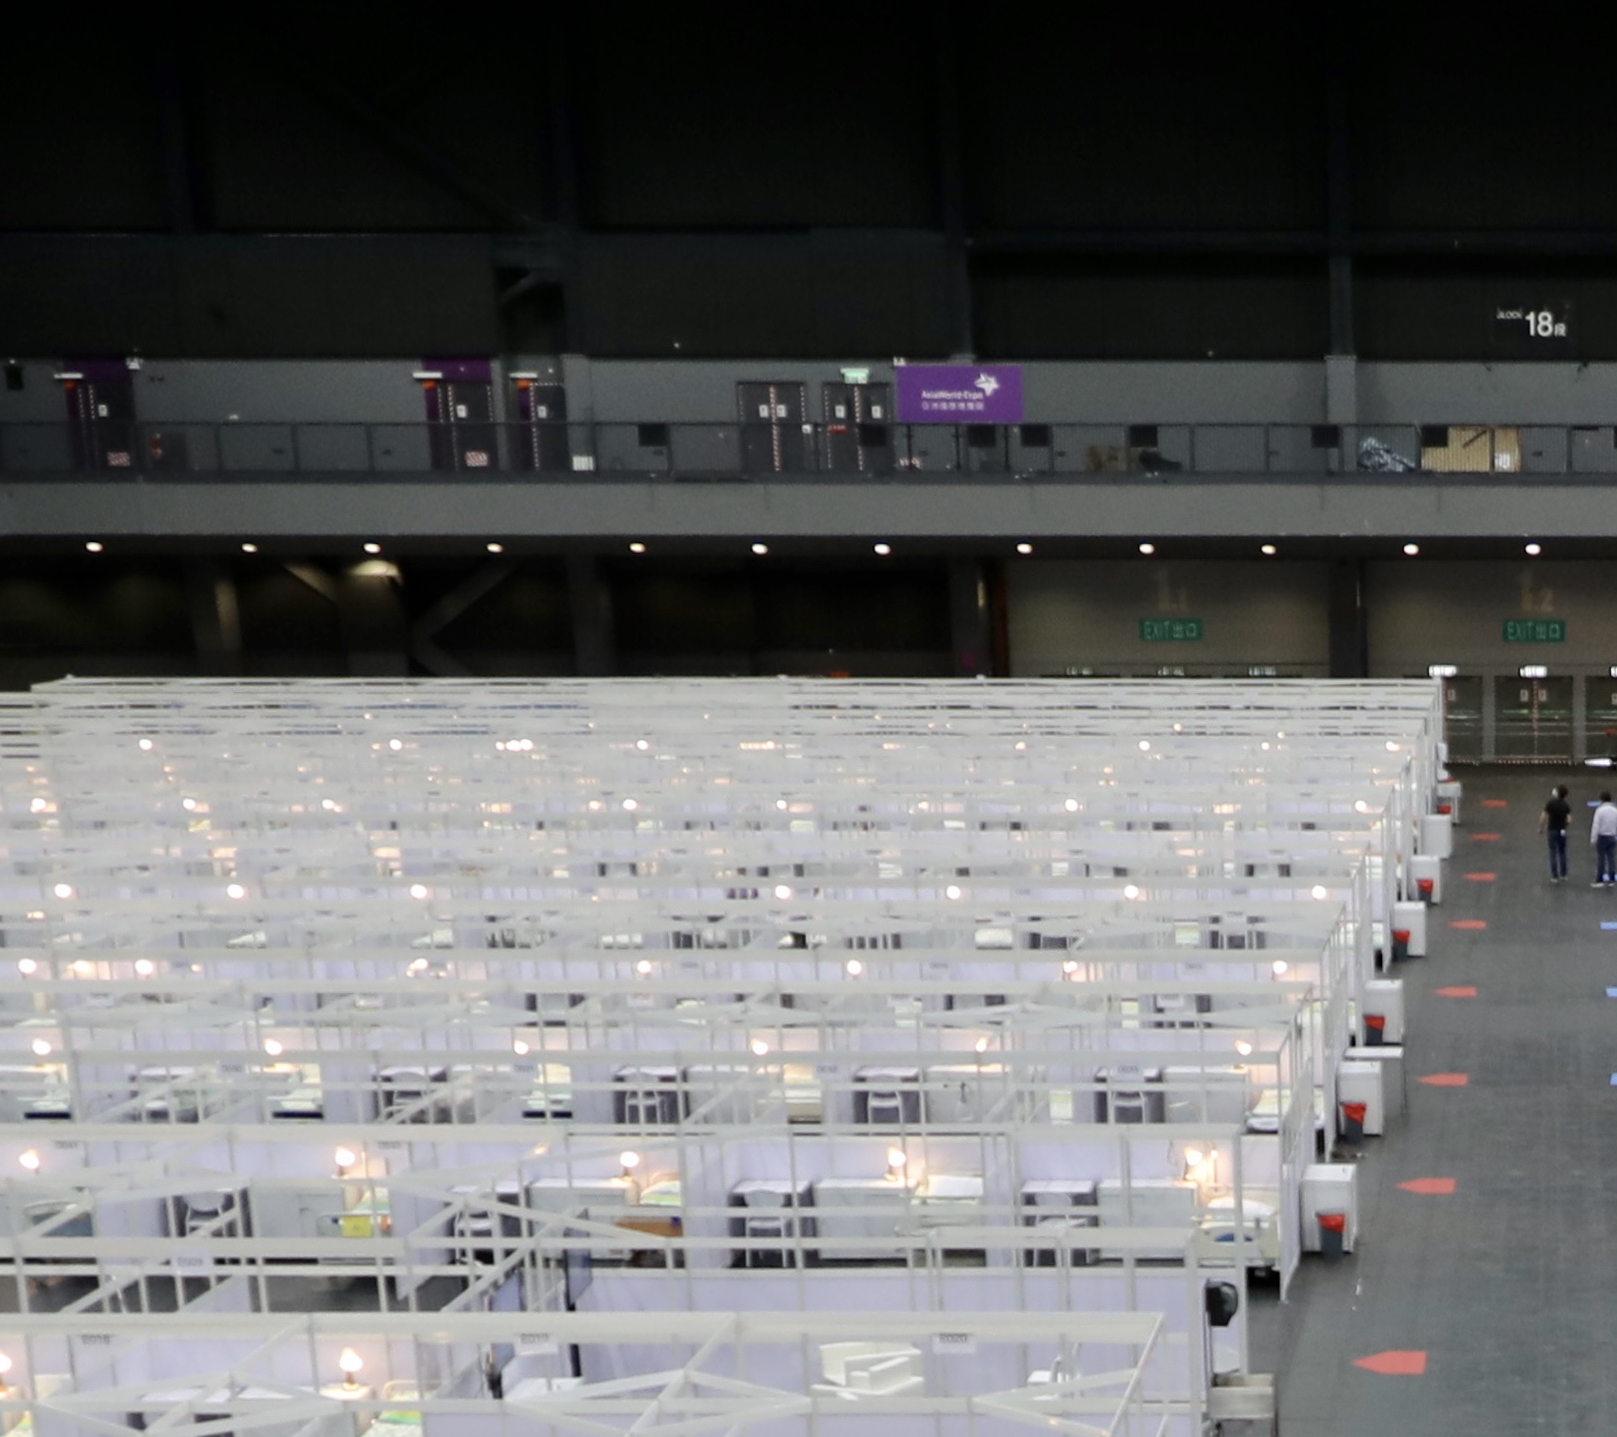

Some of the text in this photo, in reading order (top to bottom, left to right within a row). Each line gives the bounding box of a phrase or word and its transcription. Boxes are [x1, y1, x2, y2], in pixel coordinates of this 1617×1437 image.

[1525, 311, 1554, 337] 18
[921, 390, 983, 401] AsiaWorld-Expo
[1144, 621, 1197, 638] EXIT 出口
[1507, 622, 1561, 640] EXIT 出口
